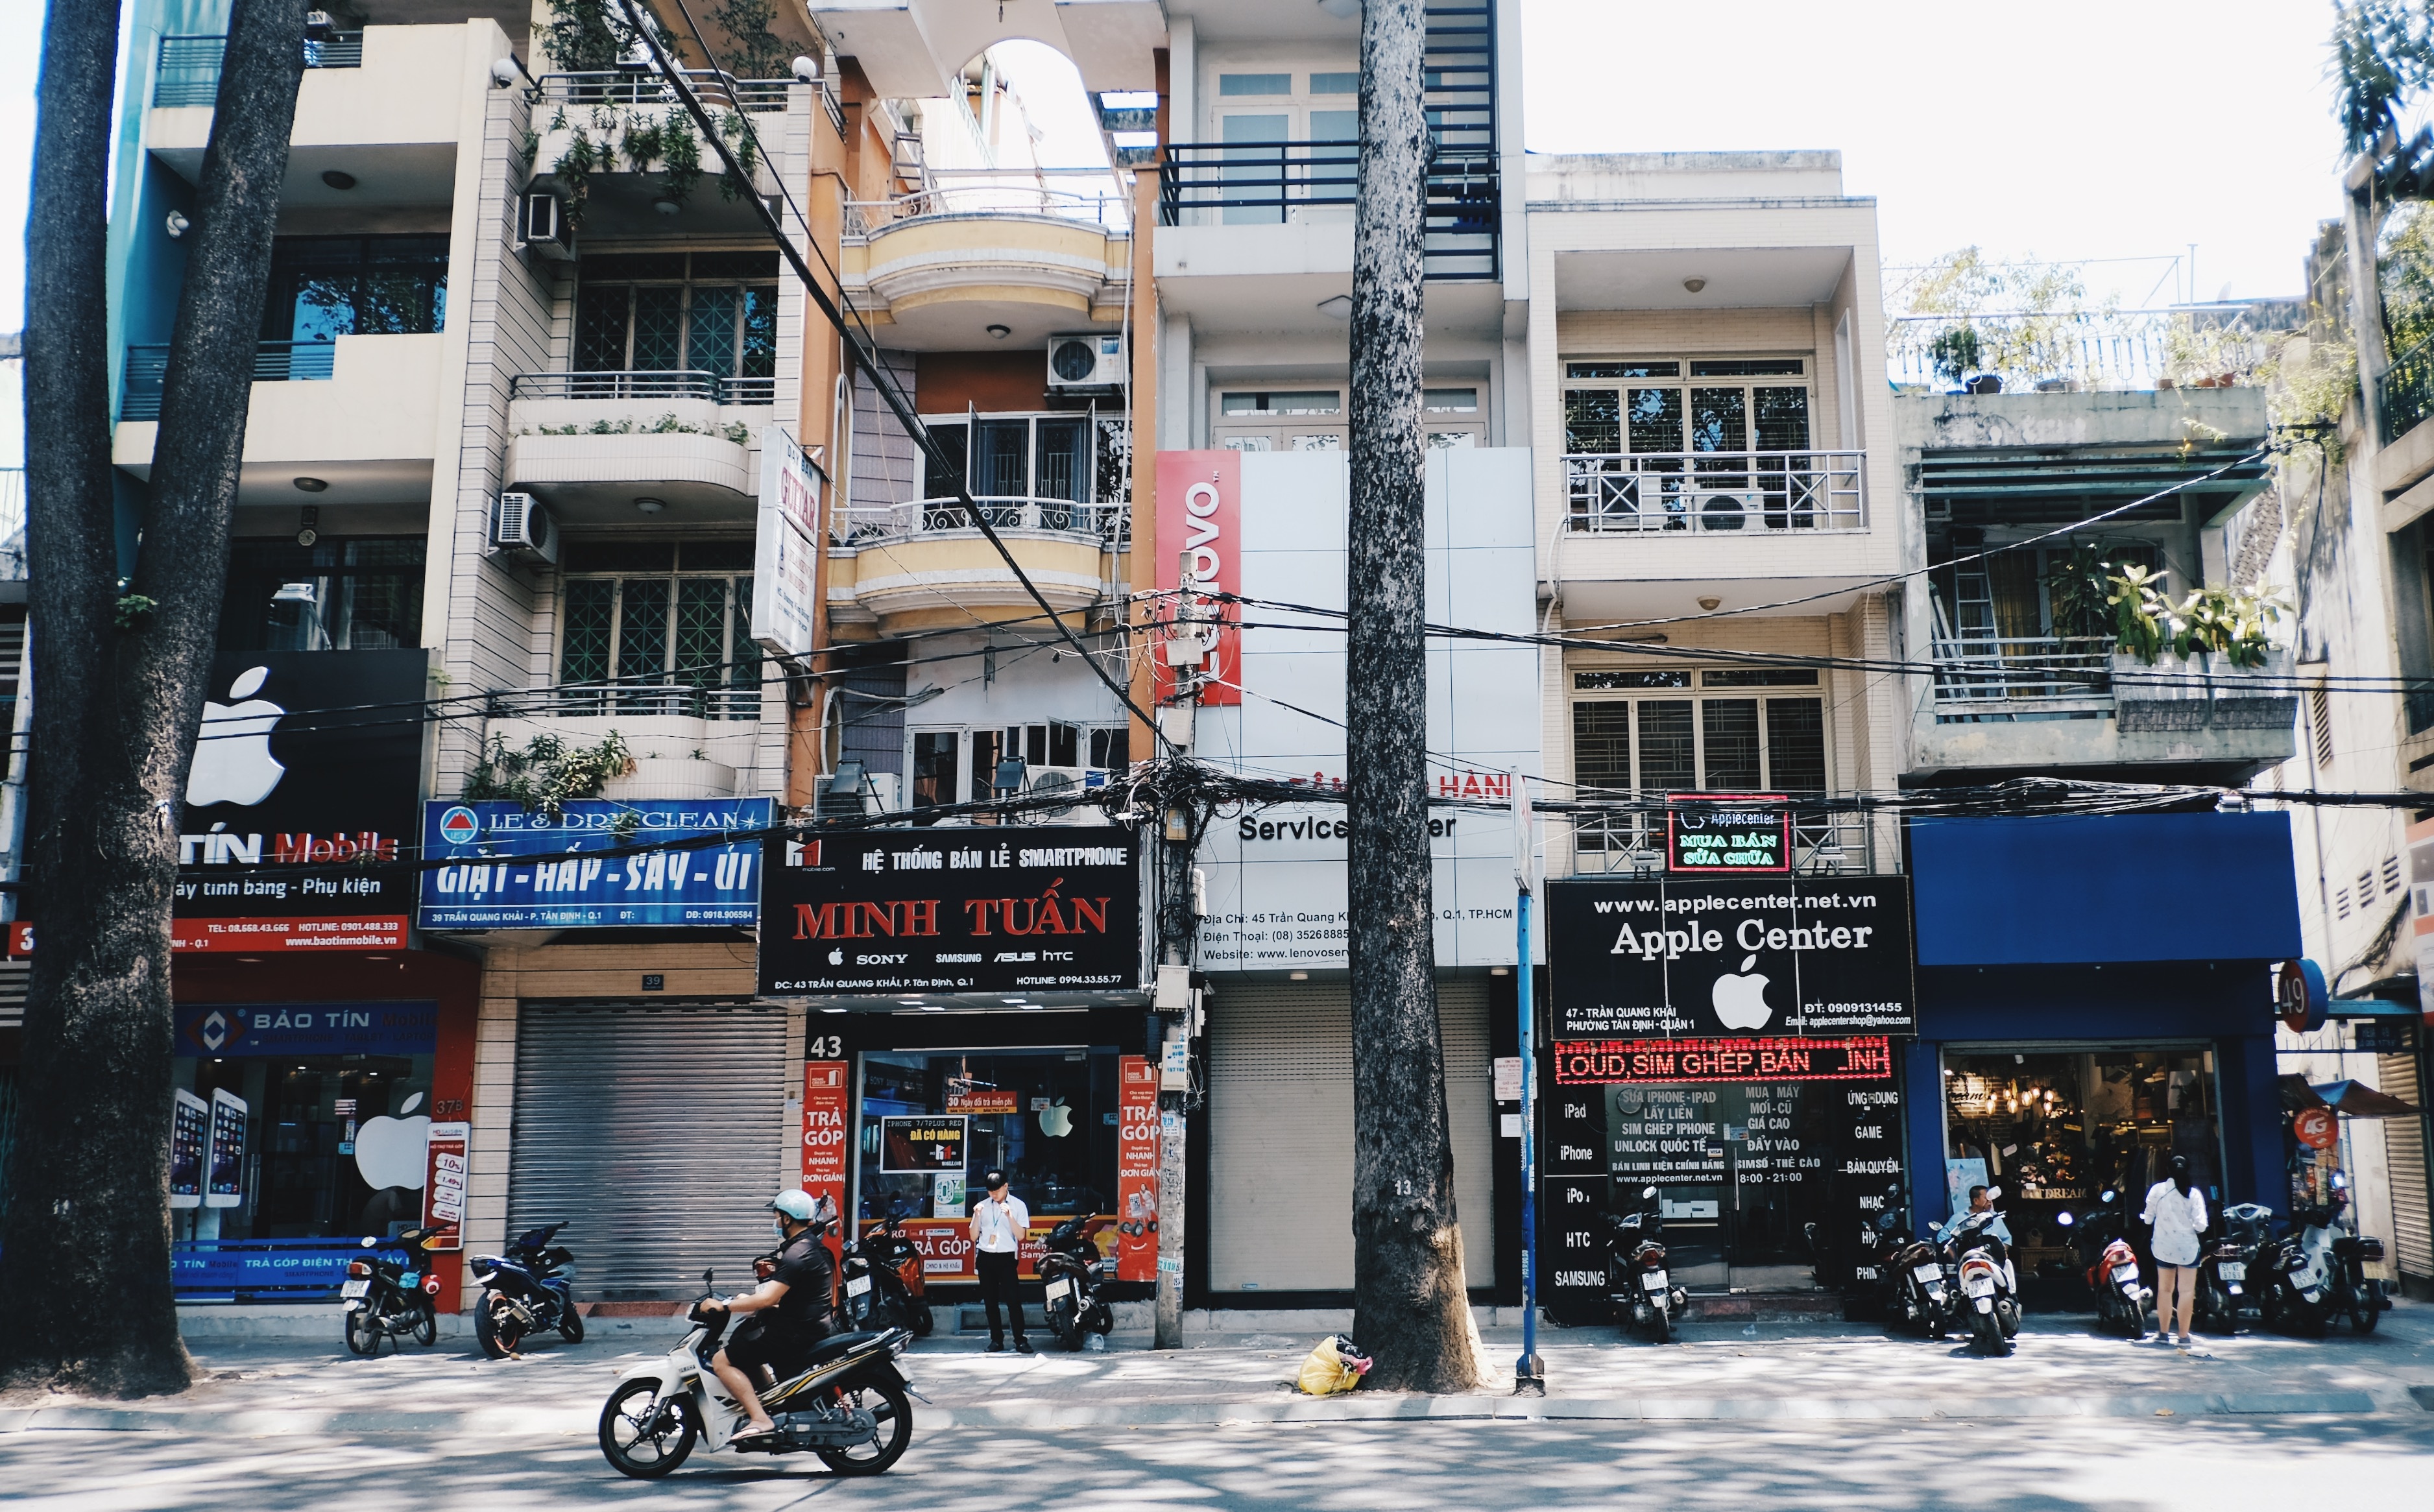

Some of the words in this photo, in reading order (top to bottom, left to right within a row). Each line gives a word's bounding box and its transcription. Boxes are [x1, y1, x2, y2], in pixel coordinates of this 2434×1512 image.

[490, 813, 551, 829] LE'S
[642, 811, 739, 828] CLEAN
[1238, 815, 1349, 840] Service
[179, 821, 262, 865] TÍN
[274, 832, 399, 863] Mobile
[1679, 834, 1728, 848] MUA
[1730, 832, 1777, 848] BÁN
[862, 848, 884, 874] HỆ
[891, 844, 943, 870] THỐNG
[950, 845, 983, 869] BÁN
[990, 843, 1010, 869] LẺ
[1018, 847, 1127, 868] SMARTPHONE
[1683, 848, 1721, 865] SỬA
[1723, 849, 1775, 865] CHỮA
[302, 878, 337, 897] Phụ
[343, 877, 381, 896] kiện
[792, 899, 941, 940] MINH
[964, 876, 1111, 937] TUẤN
[1594, 894, 1877, 913] www.applecenter.net.vn
[470, 913, 500, 922] QUANG
[502, 911, 524, 920] KHẢI
[540, 911, 558, 920] TÂN
[560, 913, 581, 921] ĐỊNH
[588, 911, 601, 920] Q.1
[703, 911, 753, 919] 0918.906584
[1203, 913, 1222, 926] Địa
[1252, 914, 1266, 924] 45
[1270, 911, 1294, 924] Trần
[1297, 912, 1336, 926] Quang
[1443, 909, 1466, 921] Q.1,
[1469, 909, 1513, 920] TP.HCM
[208, 924, 227, 933] TEL:
[298, 923, 340, 932] HOTLINE:
[341, 922, 398, 931] 0901.488.333
[195, 939, 208, 949] Q.1
[285, 934, 398, 947] www.baotinmobile.vn
[1203, 930, 1229, 942] Điện
[1233, 930, 1268, 942] Thoại:
[1271, 930, 1294, 943] (08)
[1610, 920, 1723, 961] Apple
[1736, 918, 1873, 950] Center
[856, 954, 909, 965] SONY
[935, 953, 982, 963] SAMSUNG
[993, 952, 1037, 962] ASUS
[1203, 948, 1254, 960] Website:
[645, 976, 660, 985] 39
[808, 978, 834, 989] TRẦN
[836, 979, 874, 989] QUANG
[913, 978, 930, 987] Tân
[1017, 976, 1057, 985] HOTLINE:
[1059, 975, 1122, 985] 0994.33.55.77
[2282, 978, 2304, 1014] 49
[1566, 1009, 1578, 1018] 47
[1585, 1004, 1614, 1018] TRẦN
[1616, 1007, 1650, 1018] QUANG
[1653, 1004, 1677, 1017] KHẢI
[1804, 1003, 1825, 1014] ĐT:
[1827, 1002, 1903, 1013] 0909131455
[254, 1009, 312, 1029] BẢO
[326, 1010, 369, 1027] TÍN
[1567, 1016, 1611, 1031] PHƯỜNG
[1613, 1018, 1630, 1030] TÂN
[1689, 1019, 1695, 1029] 1
[1785, 1016, 1808, 1026] Email:
[1809, 1015, 1911, 1027] applecentershop@yahoo.com
[811, 1035, 841, 1058] 43
[1647, 1091, 1685, 1103] IPHONE
[1692, 1091, 1717, 1103] IPAD
[1745, 1087, 1769, 1098] MUA
[1777, 1086, 1800, 1098] MÁY
[1848, 1090, 1868, 1105] ỨNG
[1875, 1092, 1899, 1108] DỤNG
[436, 1099, 463, 1114] 37B
[948, 1097, 959, 1107] 30
[960, 1098, 974, 1108] Ngày
[806, 1106, 843, 1126] TRẢ
[1123, 1101, 1159, 1122] TRẢ
[1564, 1103, 1587, 1119] iPad
[1622, 1123, 1642, 1135] SIM
[1645, 1120, 1673, 1135] GHÉP
[1676, 1122, 1716, 1134] IPHONE
[1748, 1116, 1766, 1130] GIÁ
[1769, 1118, 1790, 1130] CAO
[2304, 1116, 2328, 1134] 4G
[804, 1127, 844, 1146] GÓP
[910, 1129, 922, 1141] ĐÃ
[923, 1128, 936, 1140] CÓ
[937, 1129, 961, 1140] HÀNG
[1121, 1122, 1161, 1141] GÓP
[1855, 1125, 1883, 1139] GAME
[1615, 1140, 1658, 1153] UNLOCK
[1660, 1137, 1690, 1153] QUỐC
[1746, 1134, 1771, 1151] ĐẨY
[1775, 1136, 1800, 1151] VÀO
[1560, 1146, 1593, 1161] iPhone
[1776, 1156, 1795, 1168] THẺ
[1799, 1155, 1821, 1168] CÀO
[1120, 1168, 1140, 1177] ĐƠN
[1611, 1160, 1630, 1171] BÁN
[1632, 1162, 1651, 1171] LINH
[1652, 1160, 1673, 1171] KIỆN
[1675, 1159, 1700, 1170] CHÍNH
[1847, 1157, 1866, 1174] BẢN
[803, 1174, 822, 1182] ĐƠN
[823, 1171, 843, 1182] GIẢN
[1616, 1173, 1723, 1184] www.applecenter.net.vn
[1740, 1173, 1763, 1183] 8:00
[1772, 1173, 1802, 1182] 21:00
[1394, 1179, 1412, 1195] 13
[1859, 1195, 1885, 1211] NHẠC
[939, 1235, 972, 1256] GÓP
[1566, 1231, 1591, 1248] HTC
[184, 1259, 206, 1269] TÍN
[274, 1257, 299, 1267] GÓP
[302, 1257, 333, 1268] ĐIỆN
[1555, 1269, 1606, 1288] SAMSUNG
